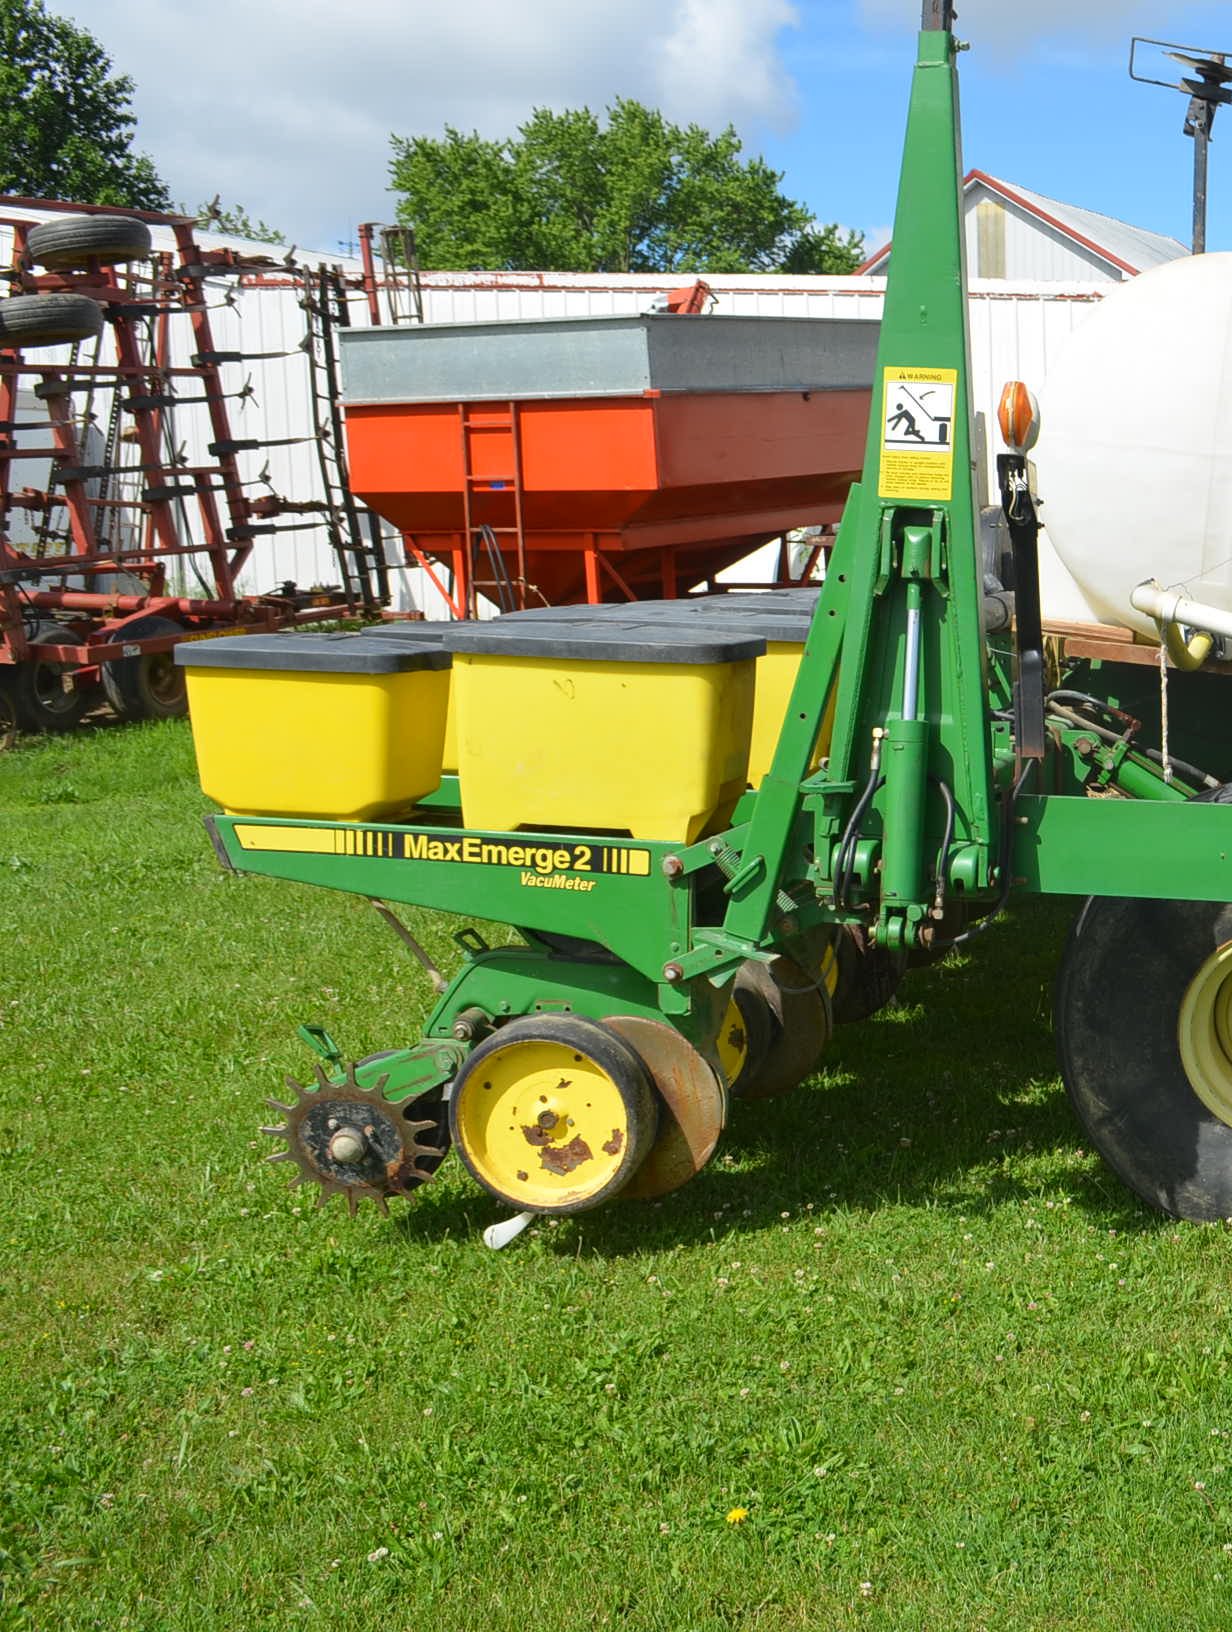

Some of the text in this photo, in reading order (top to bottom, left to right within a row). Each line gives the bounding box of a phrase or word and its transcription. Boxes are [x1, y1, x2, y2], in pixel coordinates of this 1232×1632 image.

[404, 834, 592, 873] MaxEmerge 2
[521, 871, 596, 891] VacuMeter
